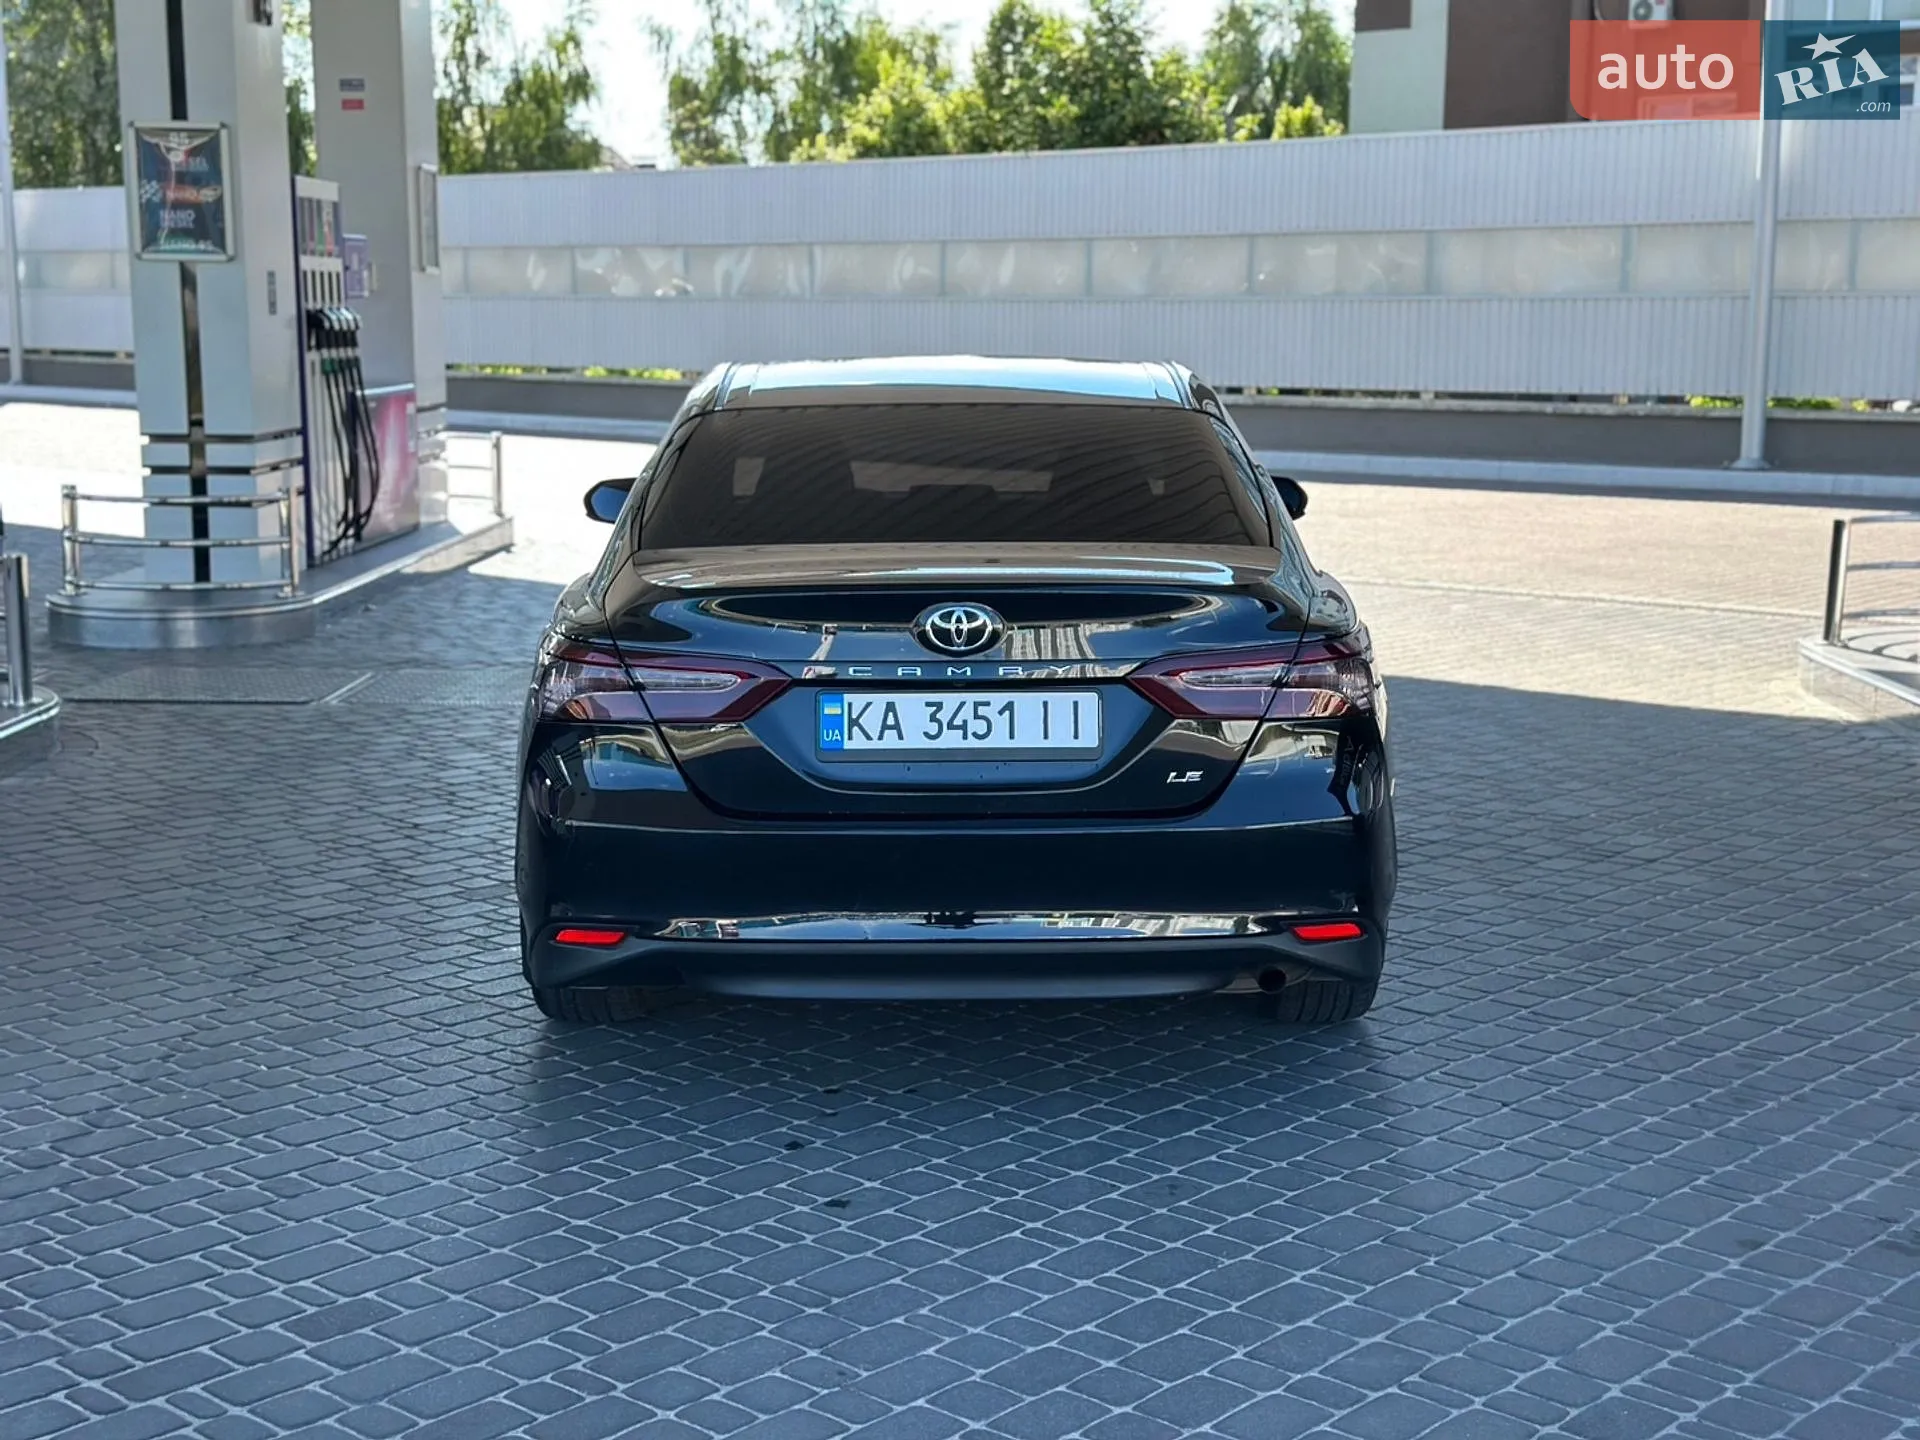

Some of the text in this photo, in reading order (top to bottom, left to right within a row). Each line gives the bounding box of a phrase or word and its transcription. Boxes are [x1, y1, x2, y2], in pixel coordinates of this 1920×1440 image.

[848, 666, 1072, 677] CAMRY
[847, 701, 904, 741] KA
[922, 701, 1016, 741] 3451
[823, 729, 842, 741] UA
[1167, 770, 1204, 784] LE
